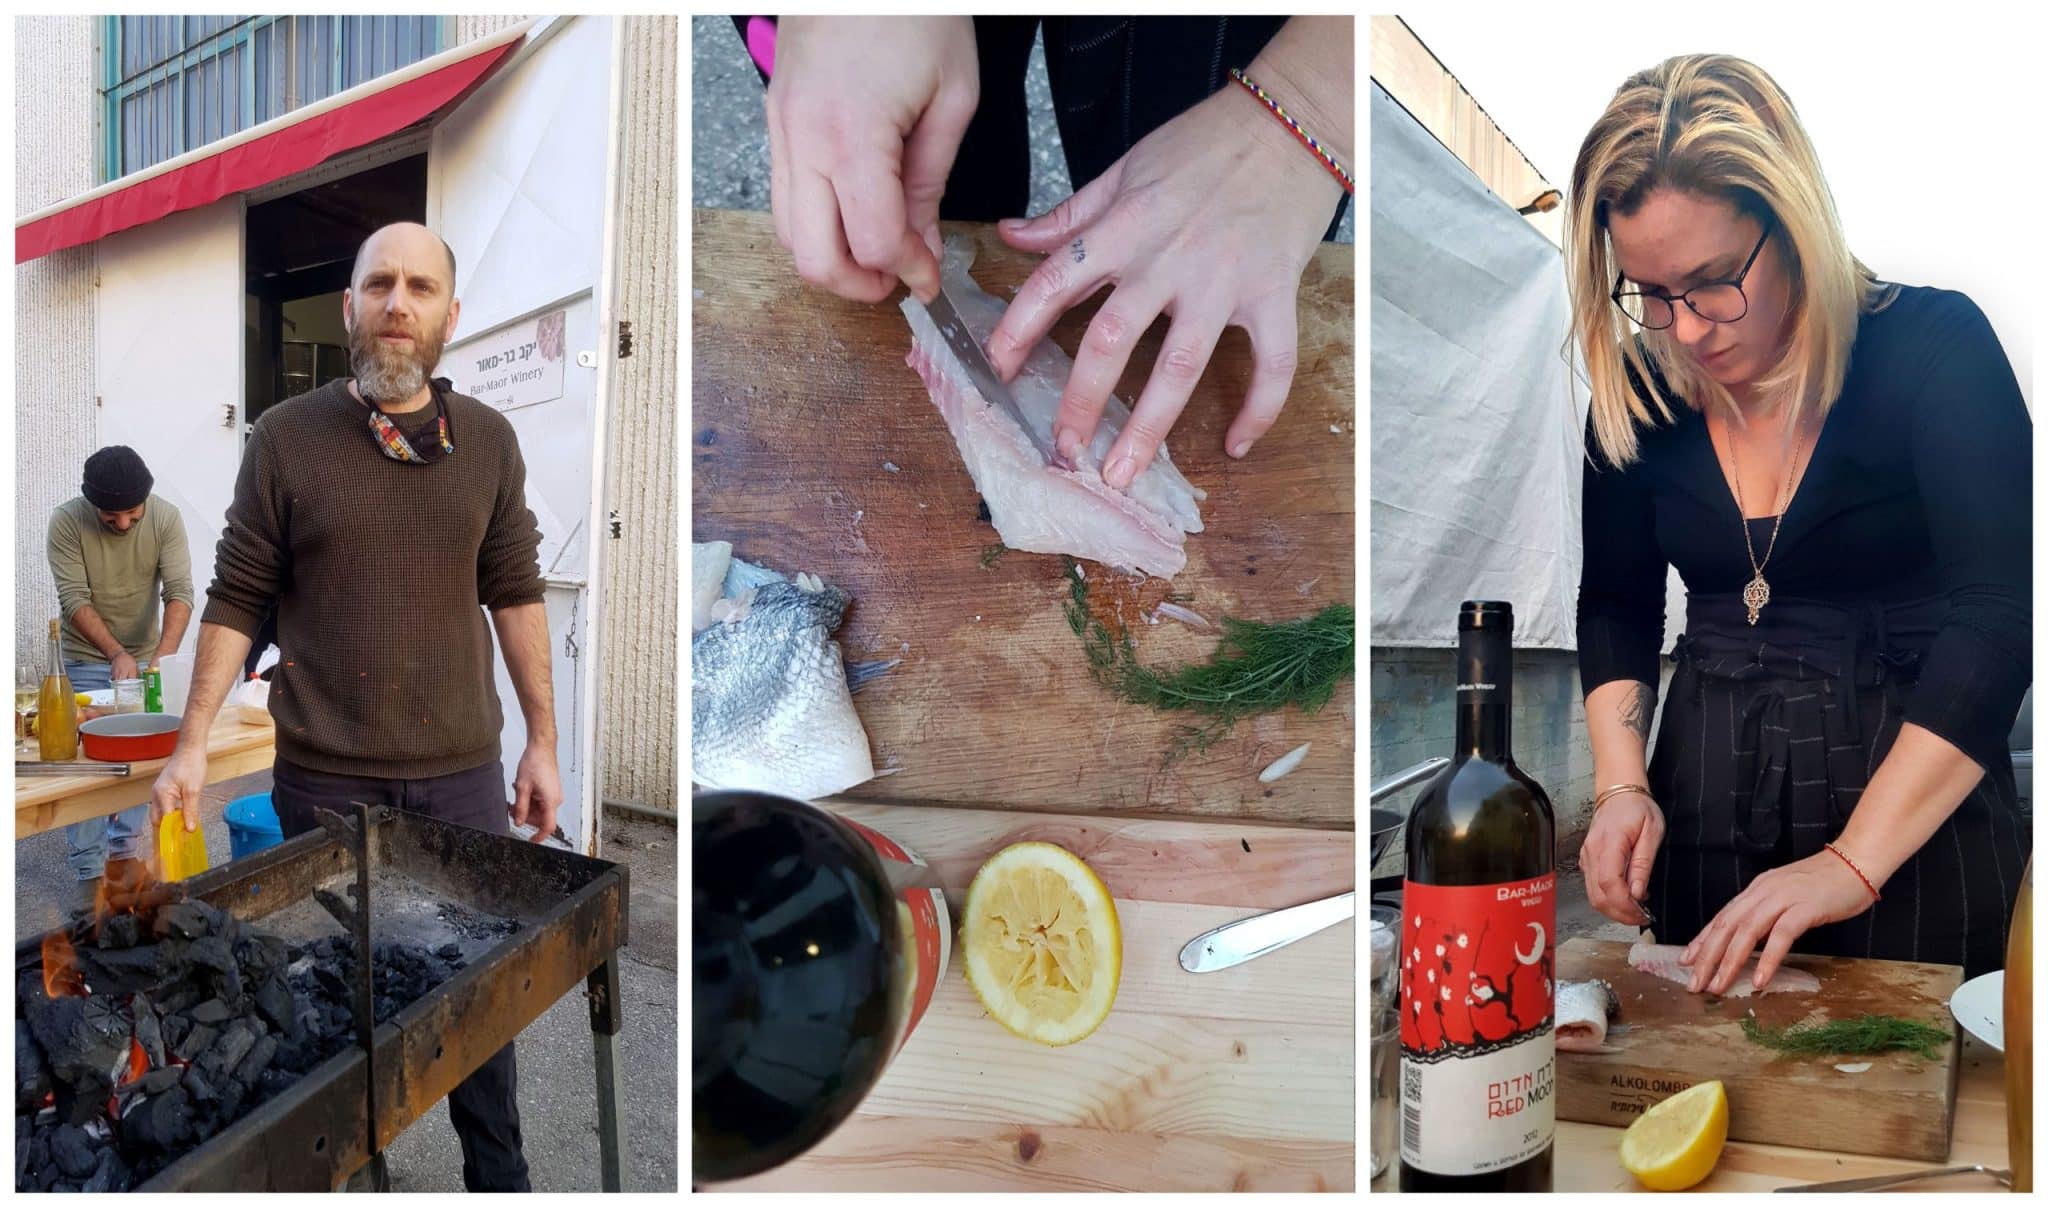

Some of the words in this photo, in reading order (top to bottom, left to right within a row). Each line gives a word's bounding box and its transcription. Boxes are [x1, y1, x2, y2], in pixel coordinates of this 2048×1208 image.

[476, 348, 516, 373] בר-מאור
[518, 342, 537, 361] יקב
[470, 378, 508, 396] Bar-Maor
[510, 366, 545, 386] Winery
[1488, 1072, 1533, 1100] אדום
[1488, 1097, 1524, 1120] RED
